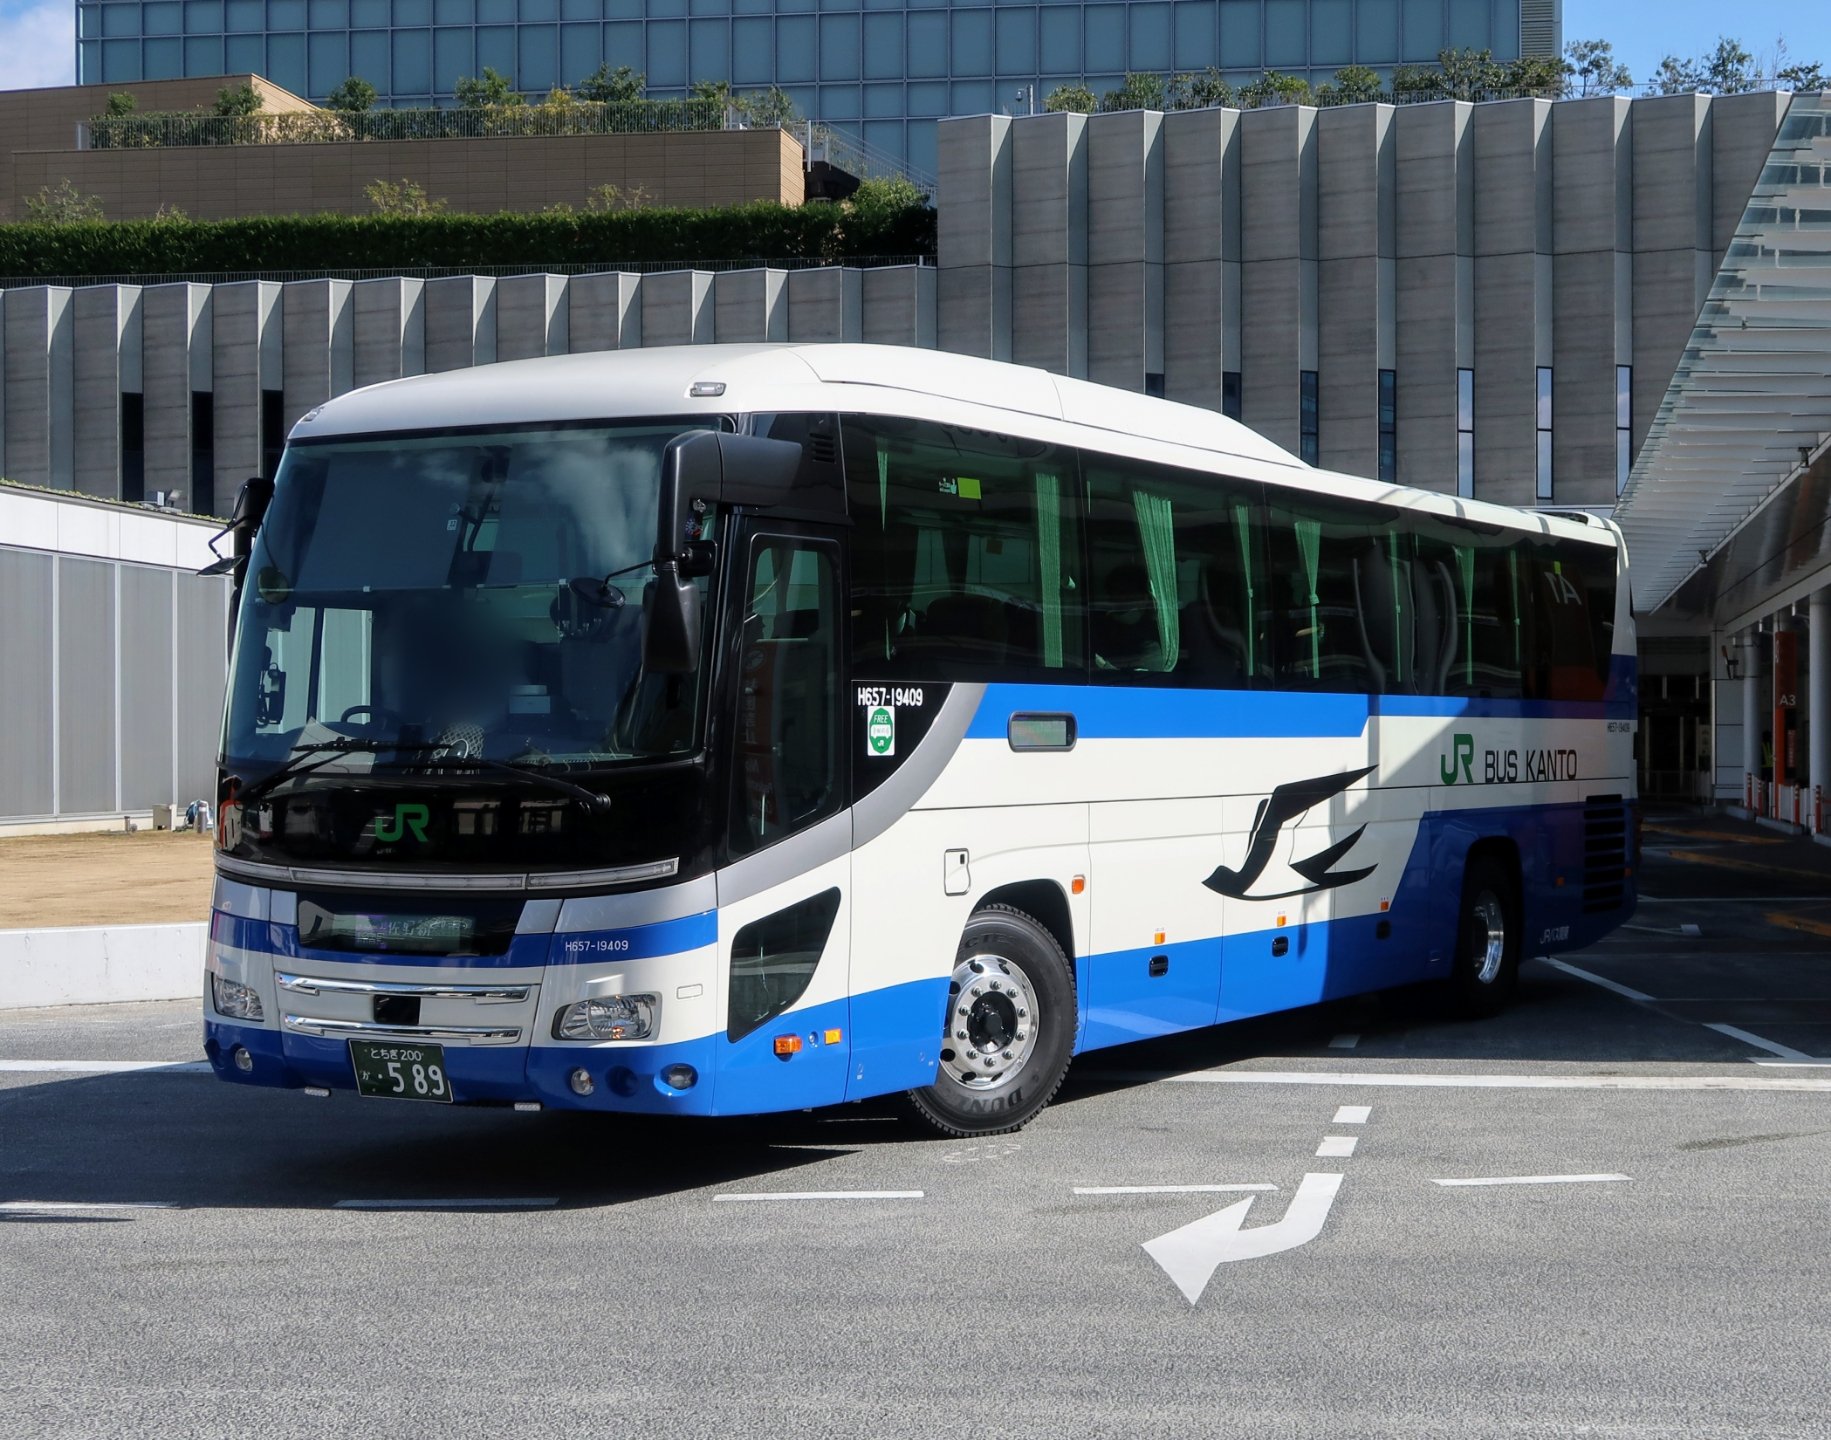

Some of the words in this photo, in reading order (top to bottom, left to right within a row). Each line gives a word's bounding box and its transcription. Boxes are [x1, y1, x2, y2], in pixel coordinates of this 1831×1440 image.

[857, 687, 923, 706] H657-19409
[1780, 694, 1796, 706] A3
[873, 714, 889, 723] FREE
[1441, 733, 1474, 785] JR
[1484, 750, 1518, 784] BUS
[1526, 749, 1577, 782] KANTO
[375, 804, 429, 842] JR
[565, 940, 629, 952] H657-19409
